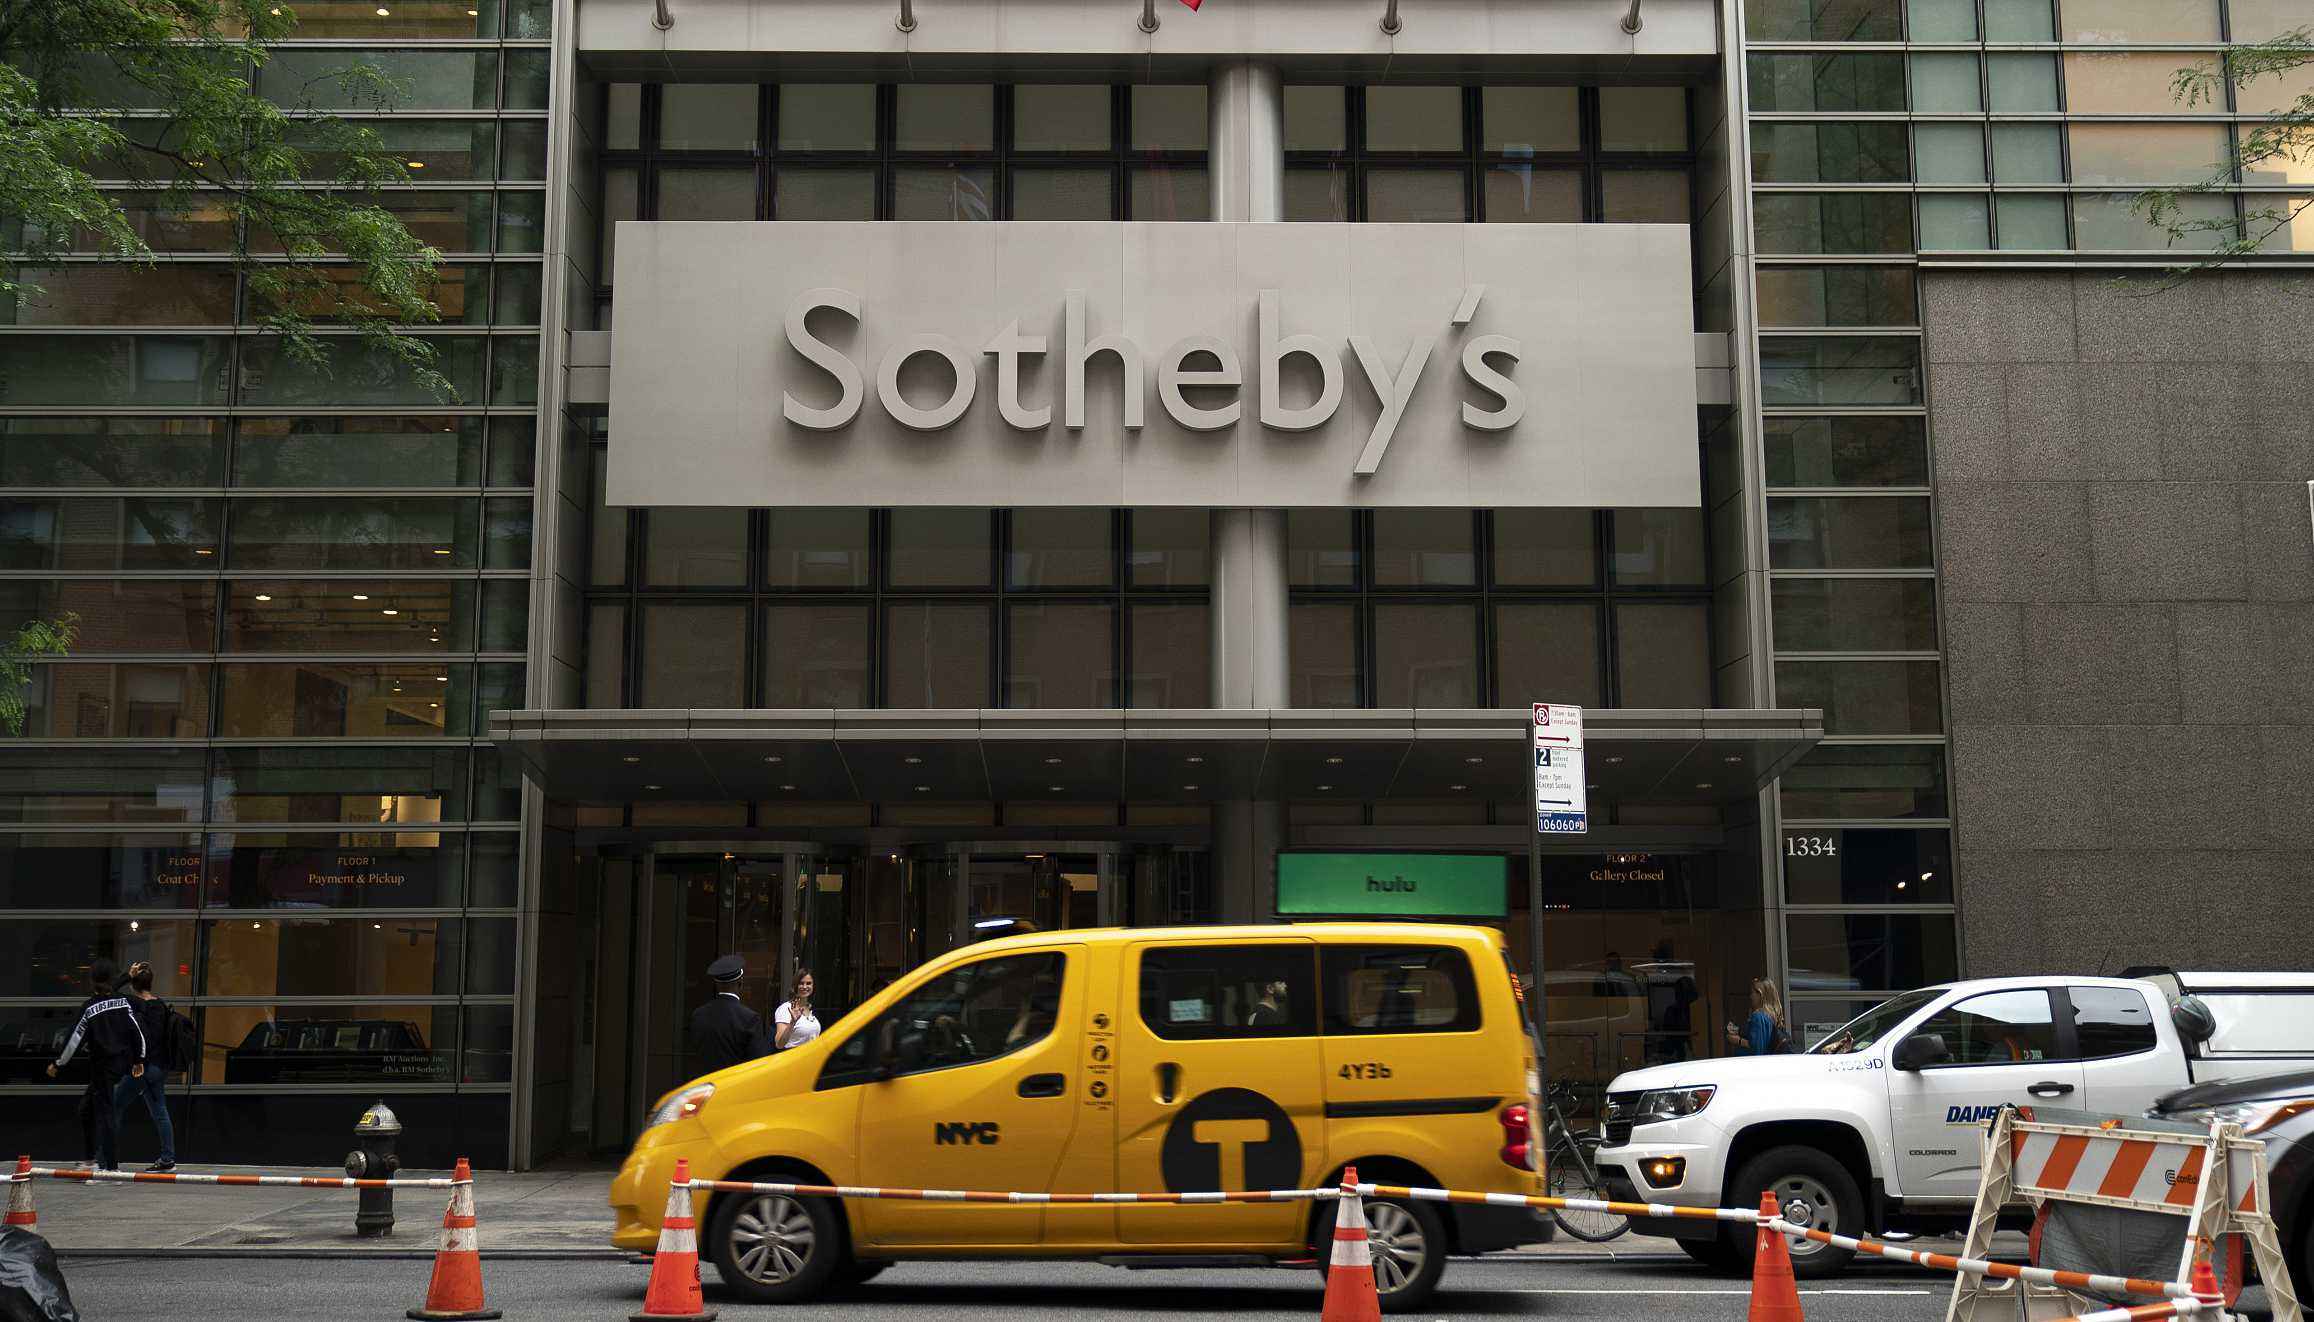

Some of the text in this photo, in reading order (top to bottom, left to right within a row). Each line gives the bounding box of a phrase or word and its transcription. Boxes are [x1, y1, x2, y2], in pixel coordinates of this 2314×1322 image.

[783, 284, 1526, 477] Sotheby's
[1539, 749, 1548, 766] 2
[1539, 819, 1575, 831] 106060
[1787, 837, 1836, 857] 1334
[336, 857, 369, 866] FLOOR
[1606, 854, 1638, 863] FLOOR
[308, 873, 406, 887] Payment & Pickup
[1366, 876, 1417, 893] hulu
[1590, 869, 1664, 883] Gallery Closed
[934, 1121, 1000, 1146] NYC
[1193, 1118, 1271, 1200] T
